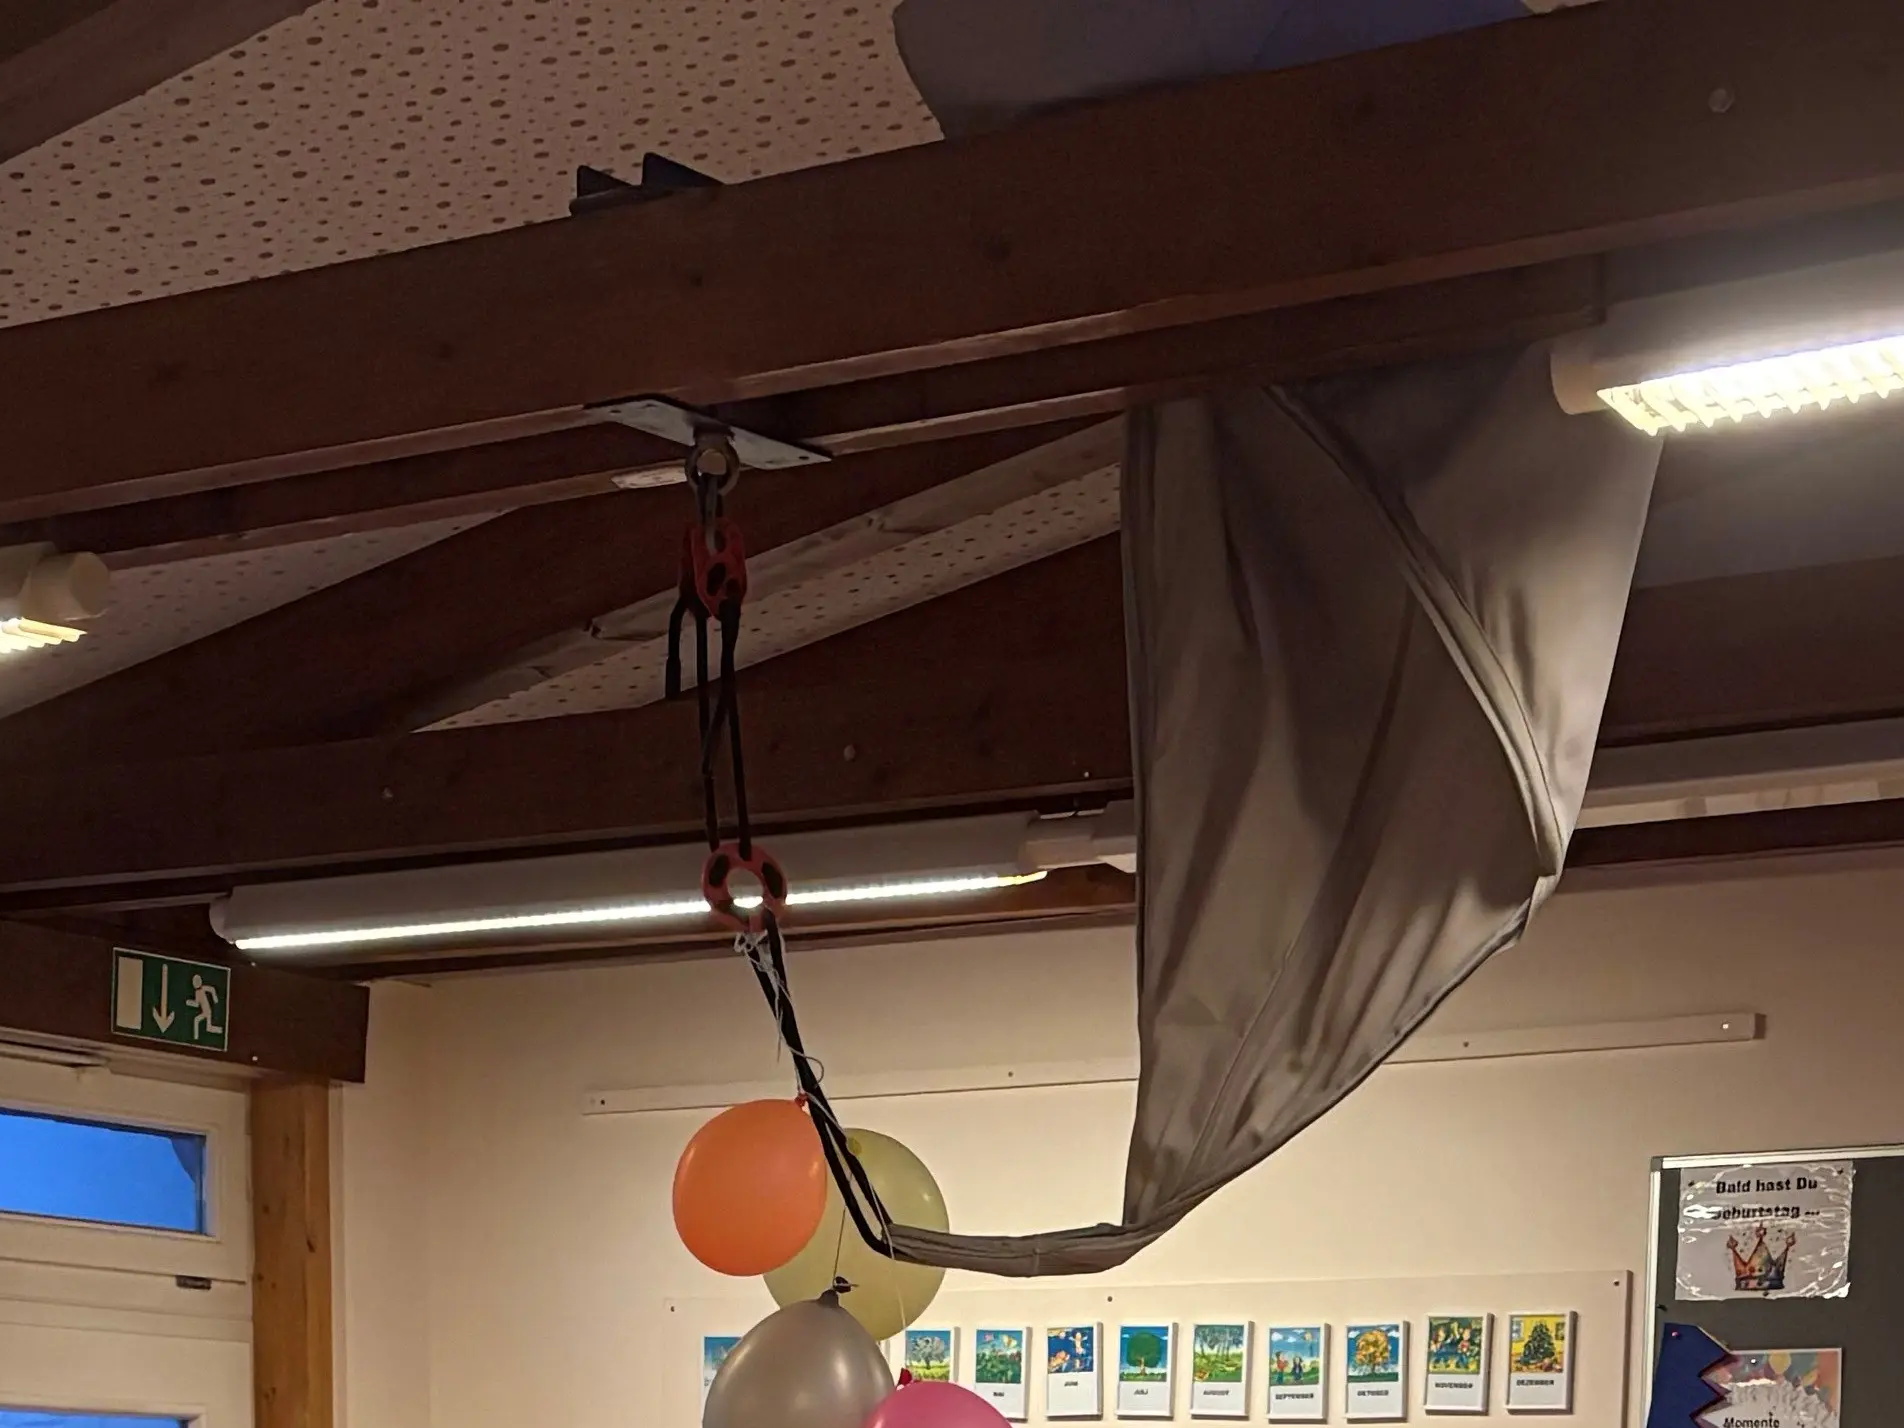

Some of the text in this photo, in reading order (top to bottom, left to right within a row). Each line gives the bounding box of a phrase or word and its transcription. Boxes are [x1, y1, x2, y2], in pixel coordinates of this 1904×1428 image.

[1716, 1177, 1818, 1194] Bald hast Du
[1723, 1418, 1780, 1428] Momente
